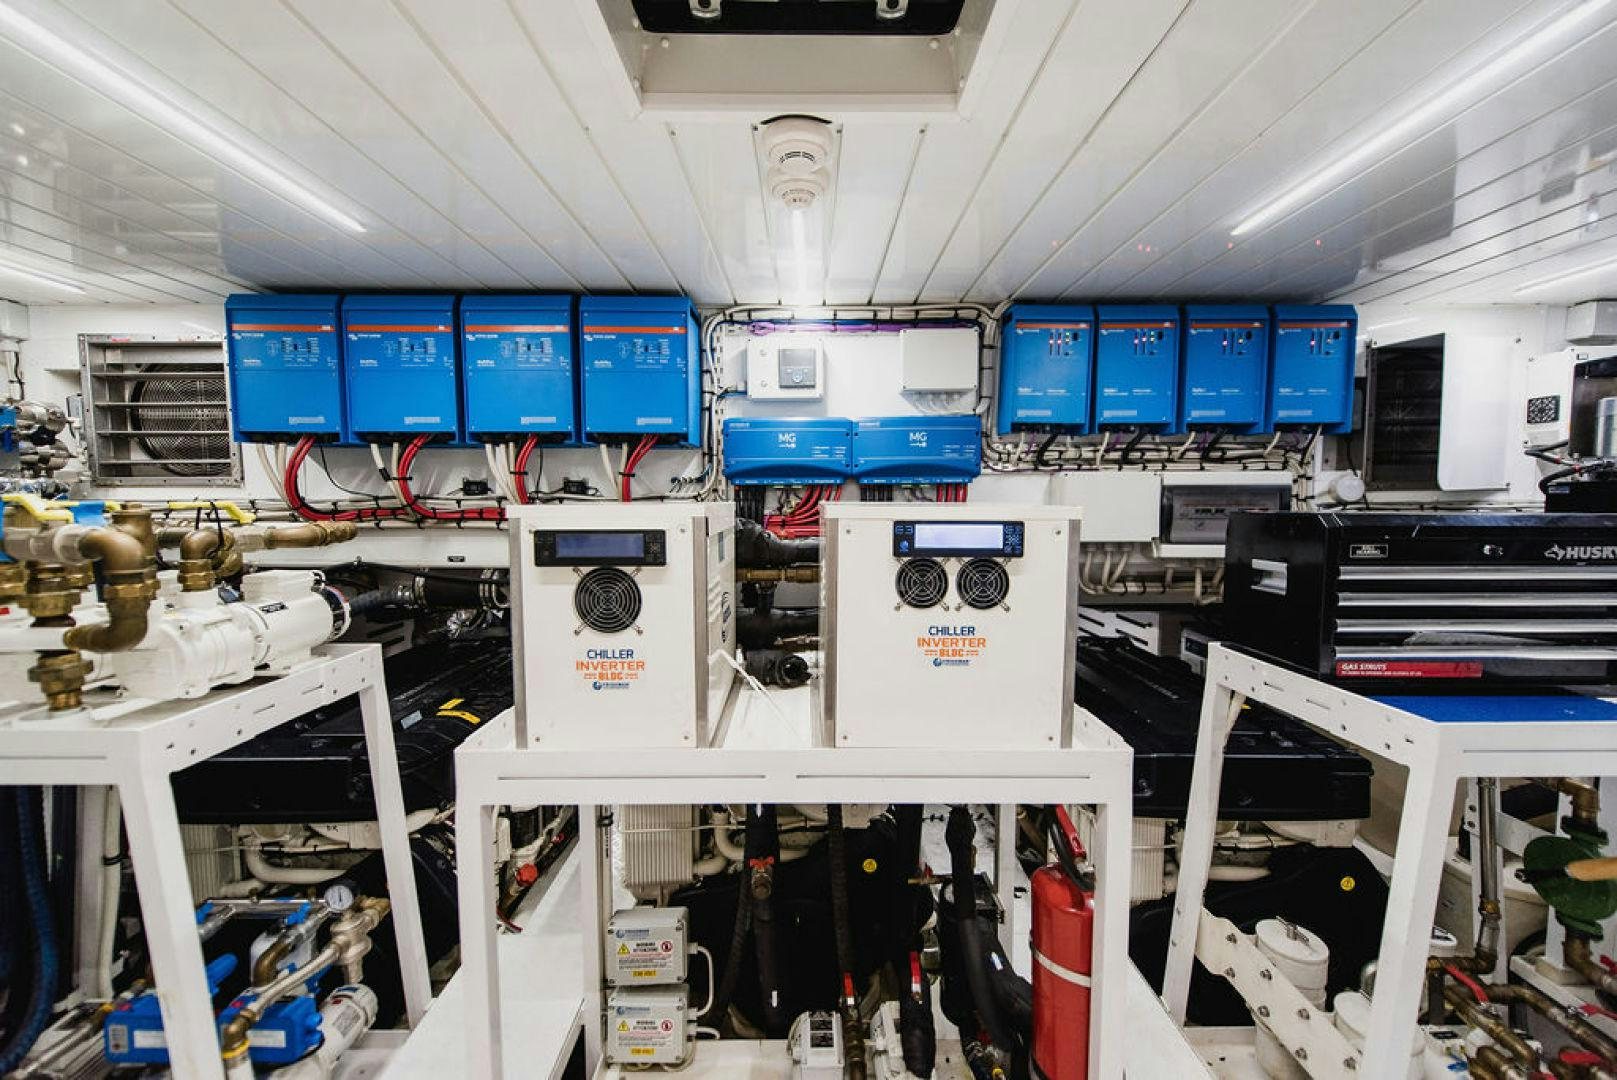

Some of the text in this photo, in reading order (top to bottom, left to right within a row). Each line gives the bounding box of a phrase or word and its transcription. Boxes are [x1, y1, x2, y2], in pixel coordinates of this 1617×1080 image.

[778, 432, 796, 443] MG
[909, 432, 928, 441] MG
[929, 626, 975, 636] CHILLER
[917, 637, 987, 648] INVERTER
[587, 649, 634, 659] CHILLER
[939, 649, 964, 657] BLDC
[576, 660, 645, 671] INVERTER
[598, 672, 623, 680] BLDC
